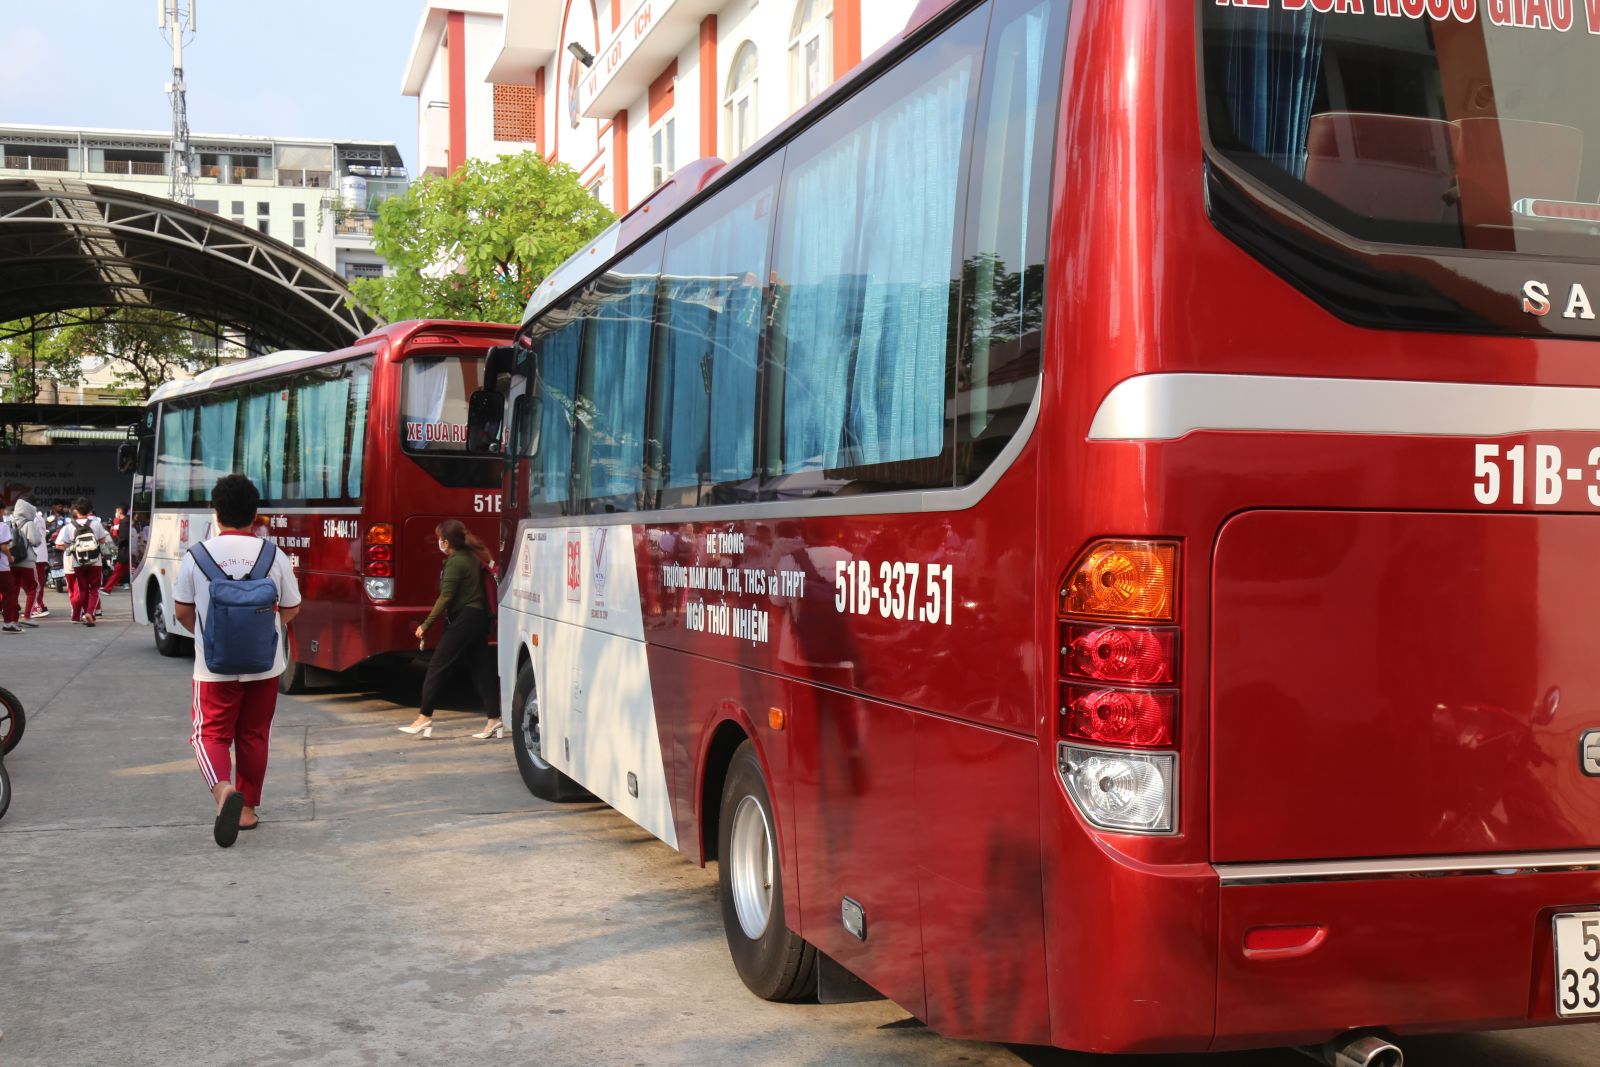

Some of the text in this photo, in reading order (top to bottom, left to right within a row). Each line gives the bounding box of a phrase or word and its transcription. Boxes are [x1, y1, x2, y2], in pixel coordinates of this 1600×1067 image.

[406, 422, 424, 442] XE
[425, 421, 449, 443] ĐƯA
[323, 520, 358, 538] 51B-404.11
[706, 523, 744, 558] HỆ THỐNG
[663, 561, 688, 588] TRƯỜNG
[707, 567, 725, 595] NON,
[744, 569, 766, 595] THCS
[768, 570, 779, 596] và
[780, 570, 806, 598] THPT
[835, 560, 953, 626] 51B-337.51
[686, 597, 769, 647] NGÔ THỜI NHIỆM
[1562, 967, 1600, 1010] 33
